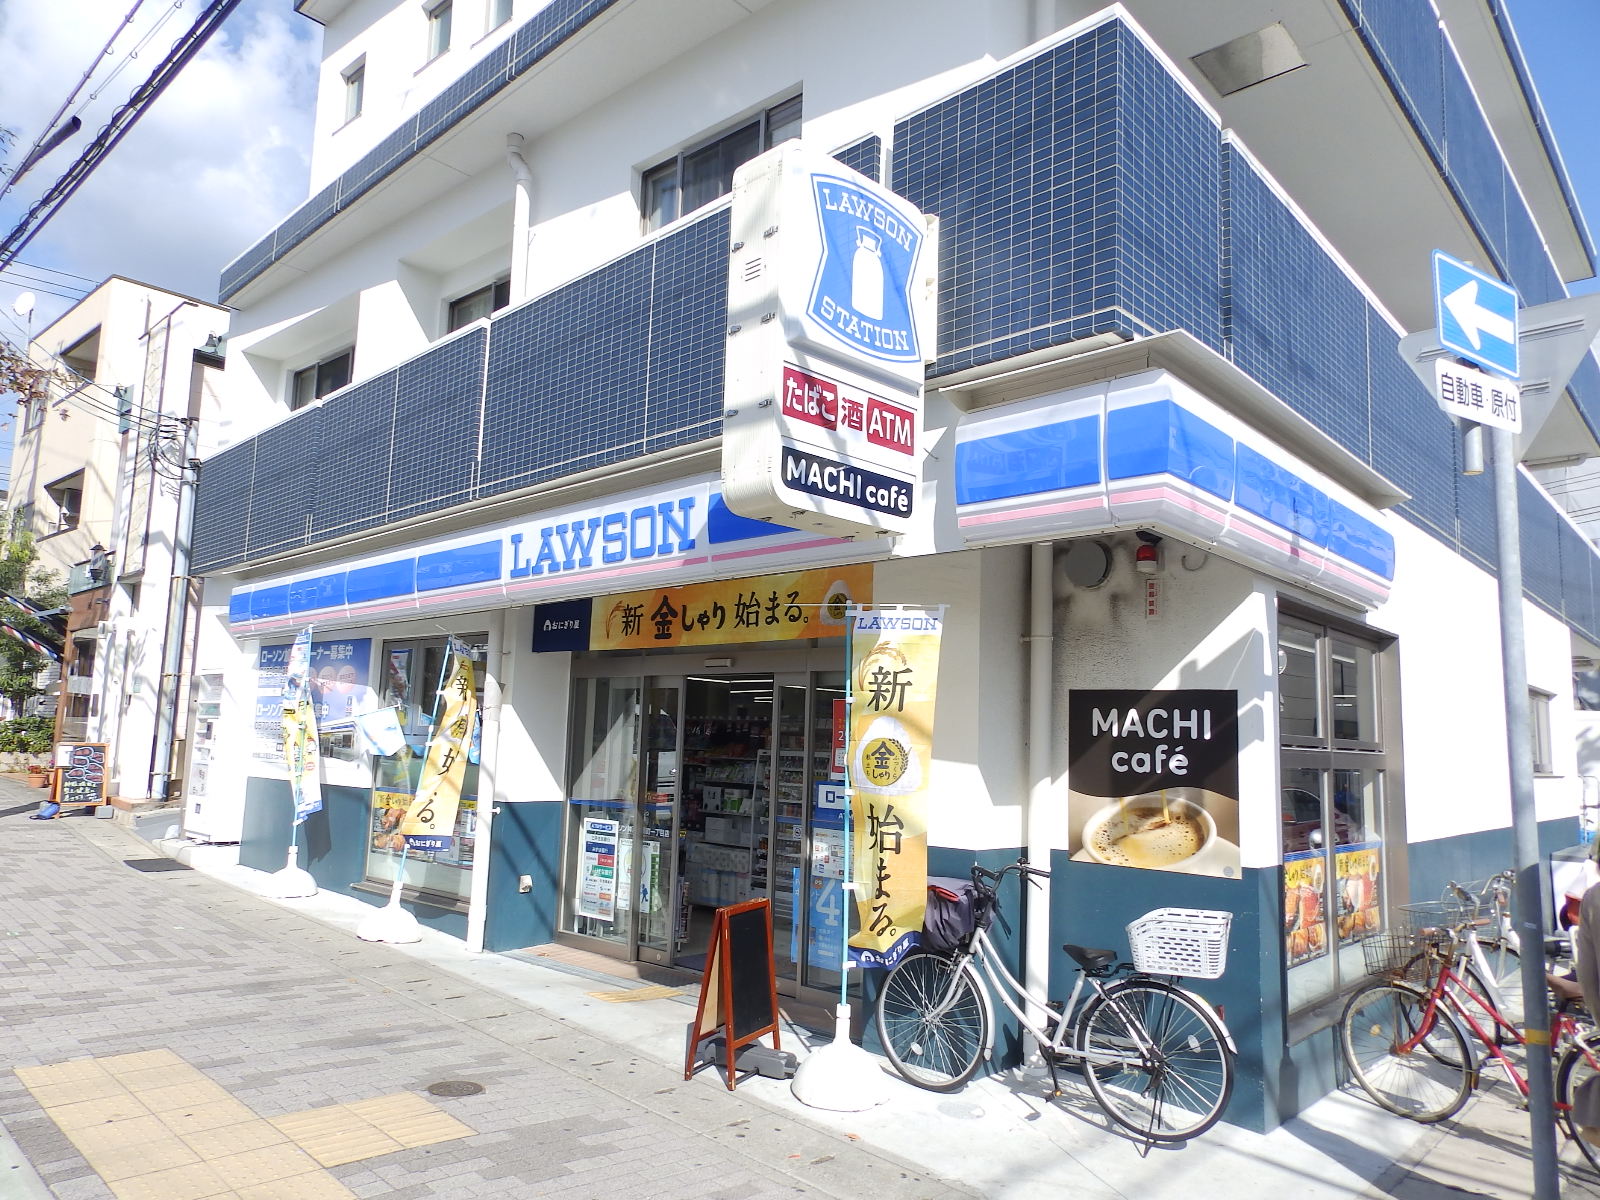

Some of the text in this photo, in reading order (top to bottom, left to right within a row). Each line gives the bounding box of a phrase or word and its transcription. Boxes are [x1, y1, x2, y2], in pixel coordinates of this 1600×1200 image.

[823, 188, 913, 251] LAWSON
[820, 295, 909, 351] STATION
[785, 377, 912, 446] たばこ 酒 ATM
[786, 455, 908, 512] MACHI café
[510, 496, 696, 578] LAWSON
[551, 619, 580, 630] おにぎり屋
[621, 591, 809, 639] 新 金しゃり 始まる。
[857, 617, 939, 631] LAWSON
[867, 666, 912, 712] 新
[1091, 707, 1212, 741] MACHI
[871, 741, 895, 769] 金
[872, 769, 891, 780] しゃり
[1111, 744, 1189, 776] café
[867, 803, 905, 937] 始まる。
